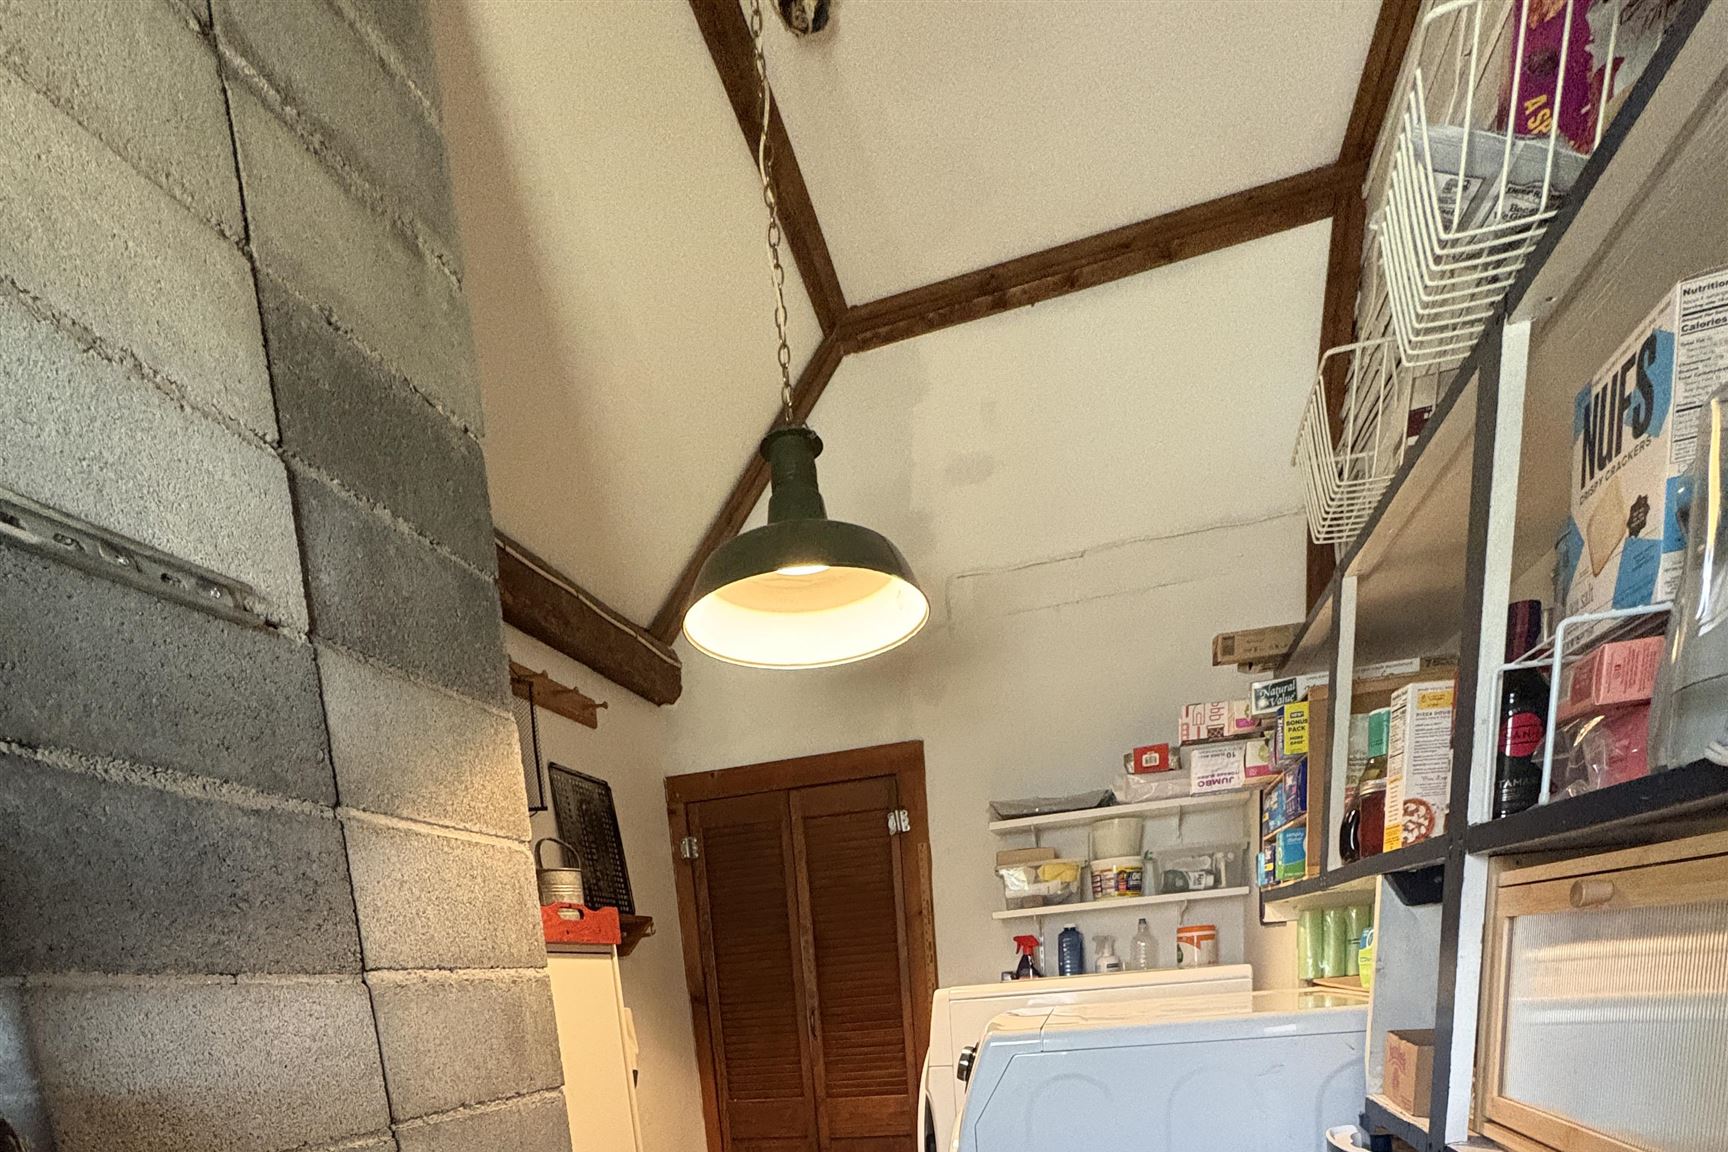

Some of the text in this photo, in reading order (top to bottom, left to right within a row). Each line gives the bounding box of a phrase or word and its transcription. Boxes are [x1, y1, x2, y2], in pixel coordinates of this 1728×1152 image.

[1681, 315, 1728, 333] Calories
[1605, 435, 1653, 483] CRACKERS
[1259, 679, 1296, 698] Natural
[1286, 718, 1308, 727] BONUS
[1288, 725, 1306, 733] PACK
[1197, 776, 1235, 788] JUMBO
